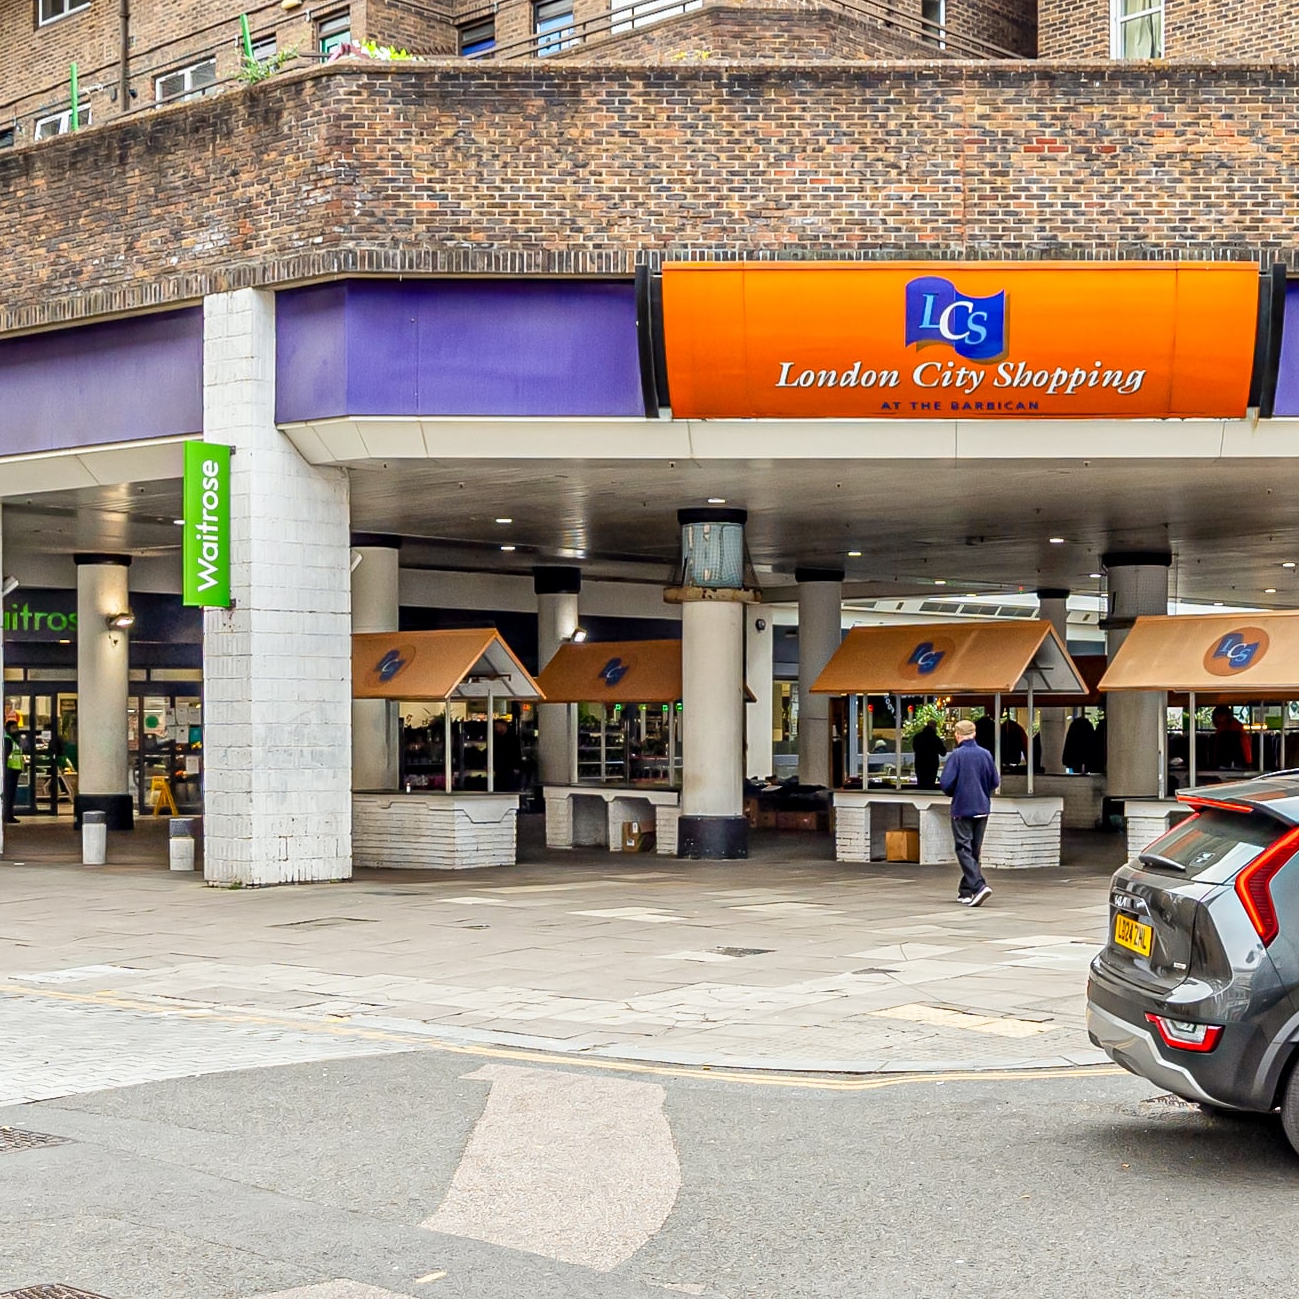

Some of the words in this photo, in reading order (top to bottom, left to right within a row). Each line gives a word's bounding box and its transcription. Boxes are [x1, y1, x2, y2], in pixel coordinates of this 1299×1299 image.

[919, 292, 988, 345] LCS
[775, 361, 901, 389] London
[912, 360, 987, 394] City
[993, 360, 1148, 396] Shopping
[880, 401, 901, 411] AT
[910, 401, 941, 411] THE
[950, 401, 1040, 411] BARBICAN
[196, 459, 219, 593] Waitrose
[4, 602, 77, 632] itros
